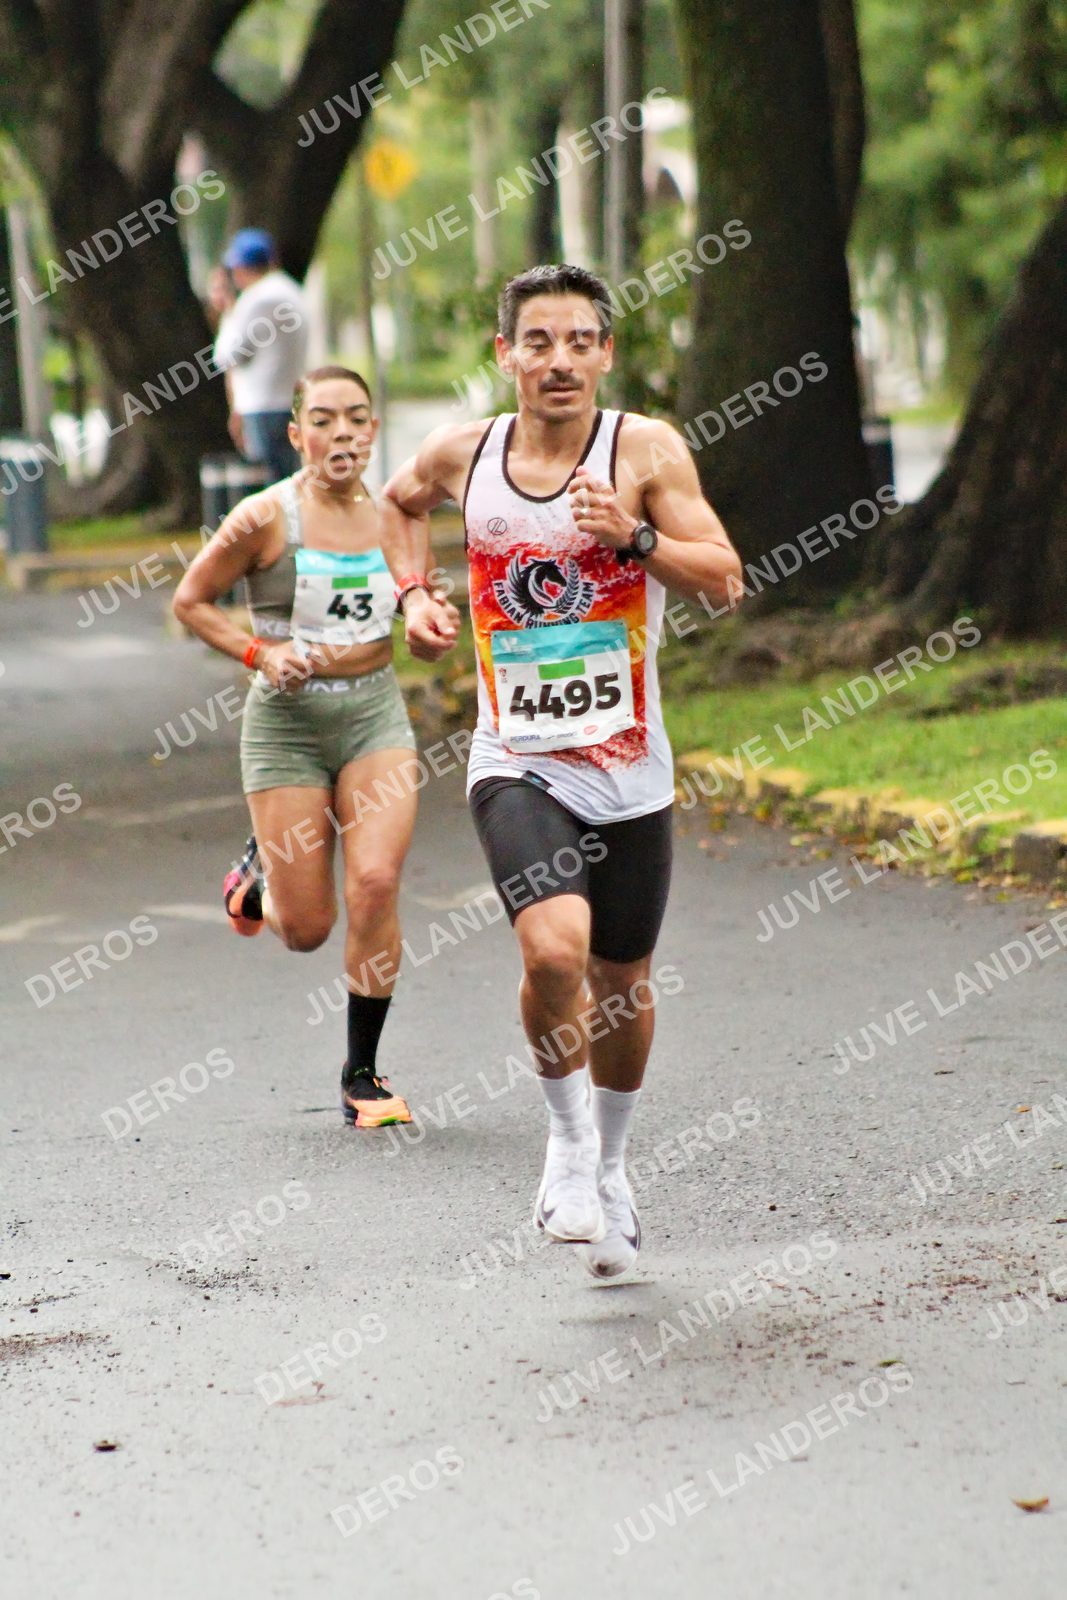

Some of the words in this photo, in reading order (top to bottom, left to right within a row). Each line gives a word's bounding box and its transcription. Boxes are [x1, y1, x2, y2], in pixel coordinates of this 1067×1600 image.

[327, 593, 373, 621] 43
[494, 582, 524, 623] FABIAN
[576, 582, 594, 614] TEAM
[509, 672, 621, 721] 4495
